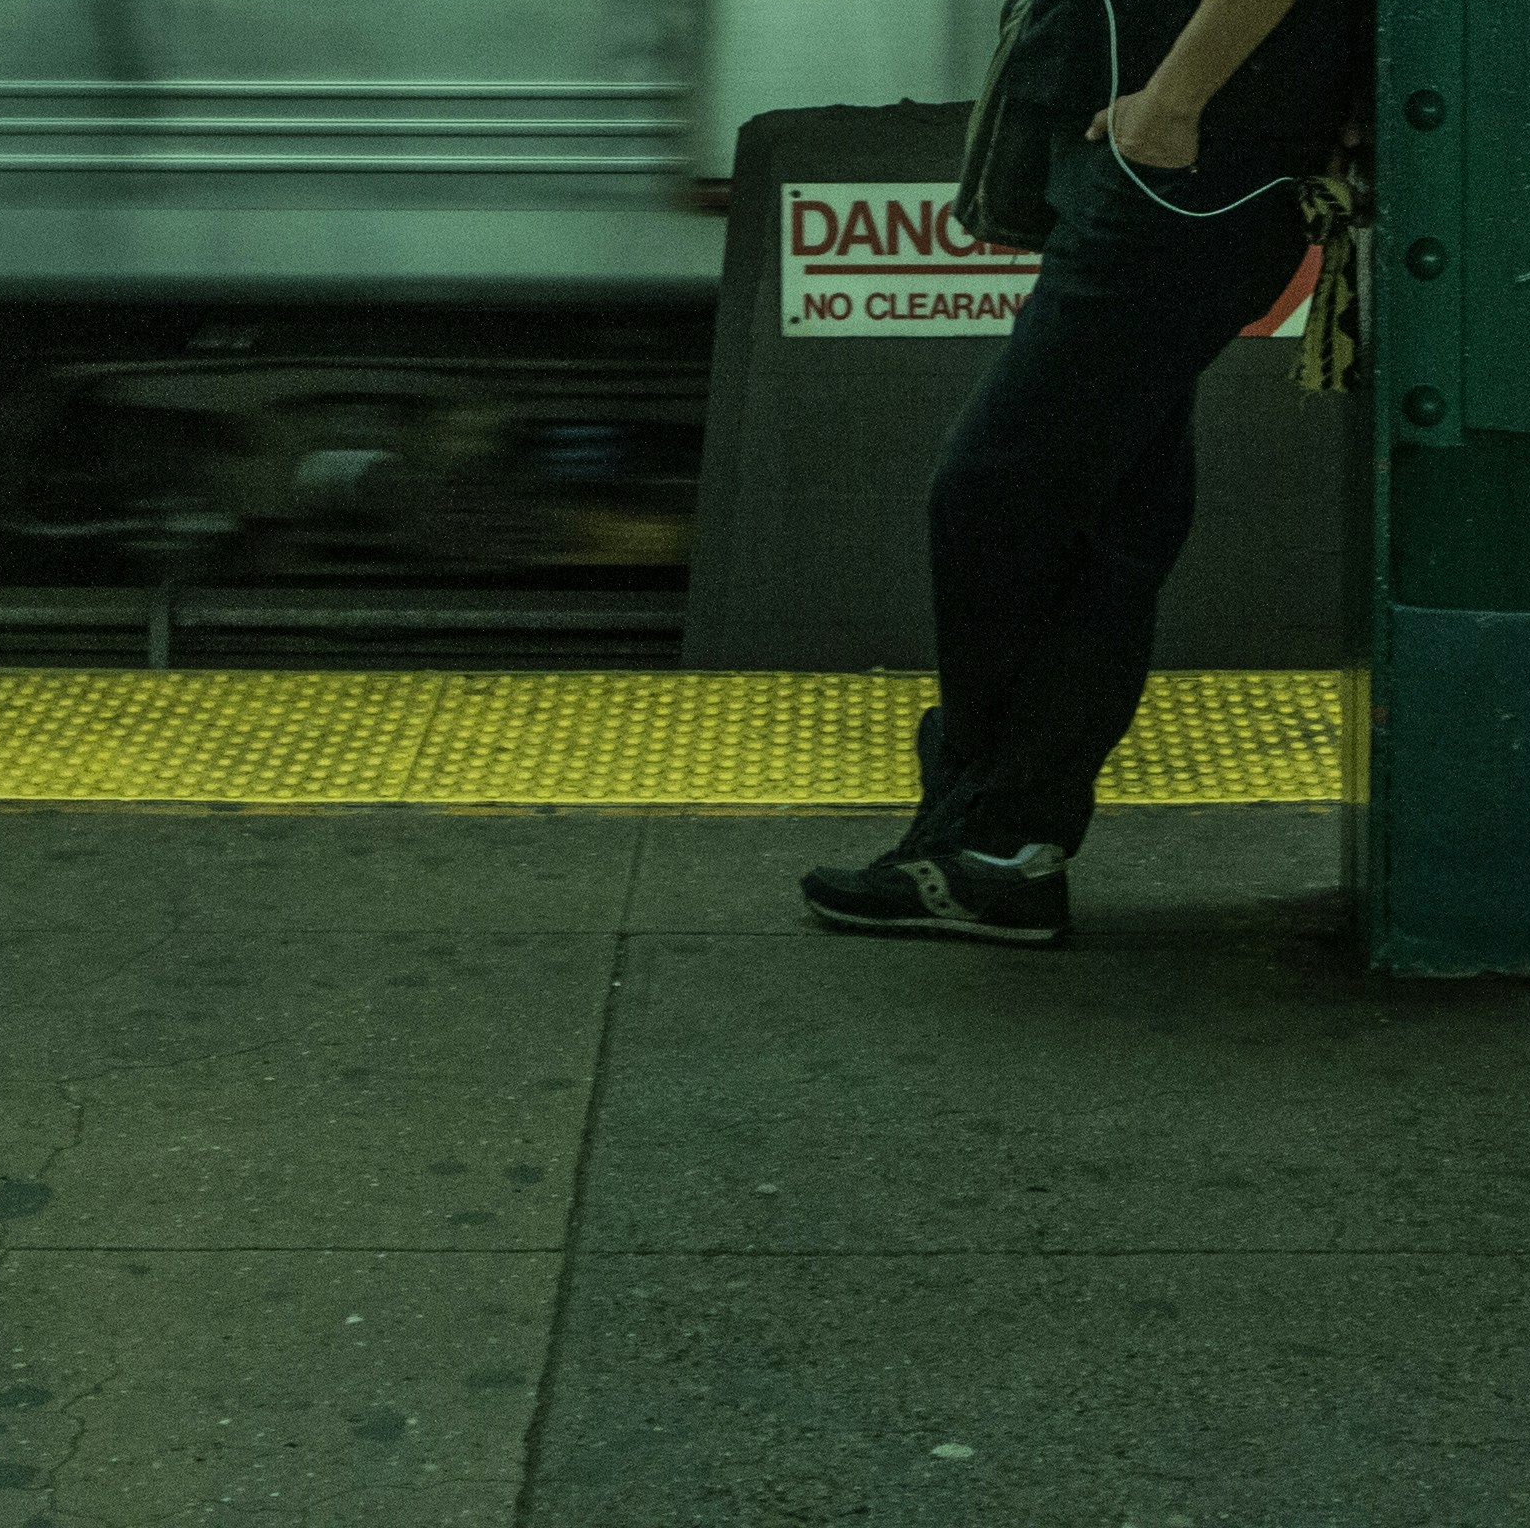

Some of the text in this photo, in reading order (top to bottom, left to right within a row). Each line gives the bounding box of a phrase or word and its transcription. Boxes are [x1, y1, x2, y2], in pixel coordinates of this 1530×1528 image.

[791, 200, 1031, 256] DANG
[804, 292, 1031, 320] NO CLEARAN
